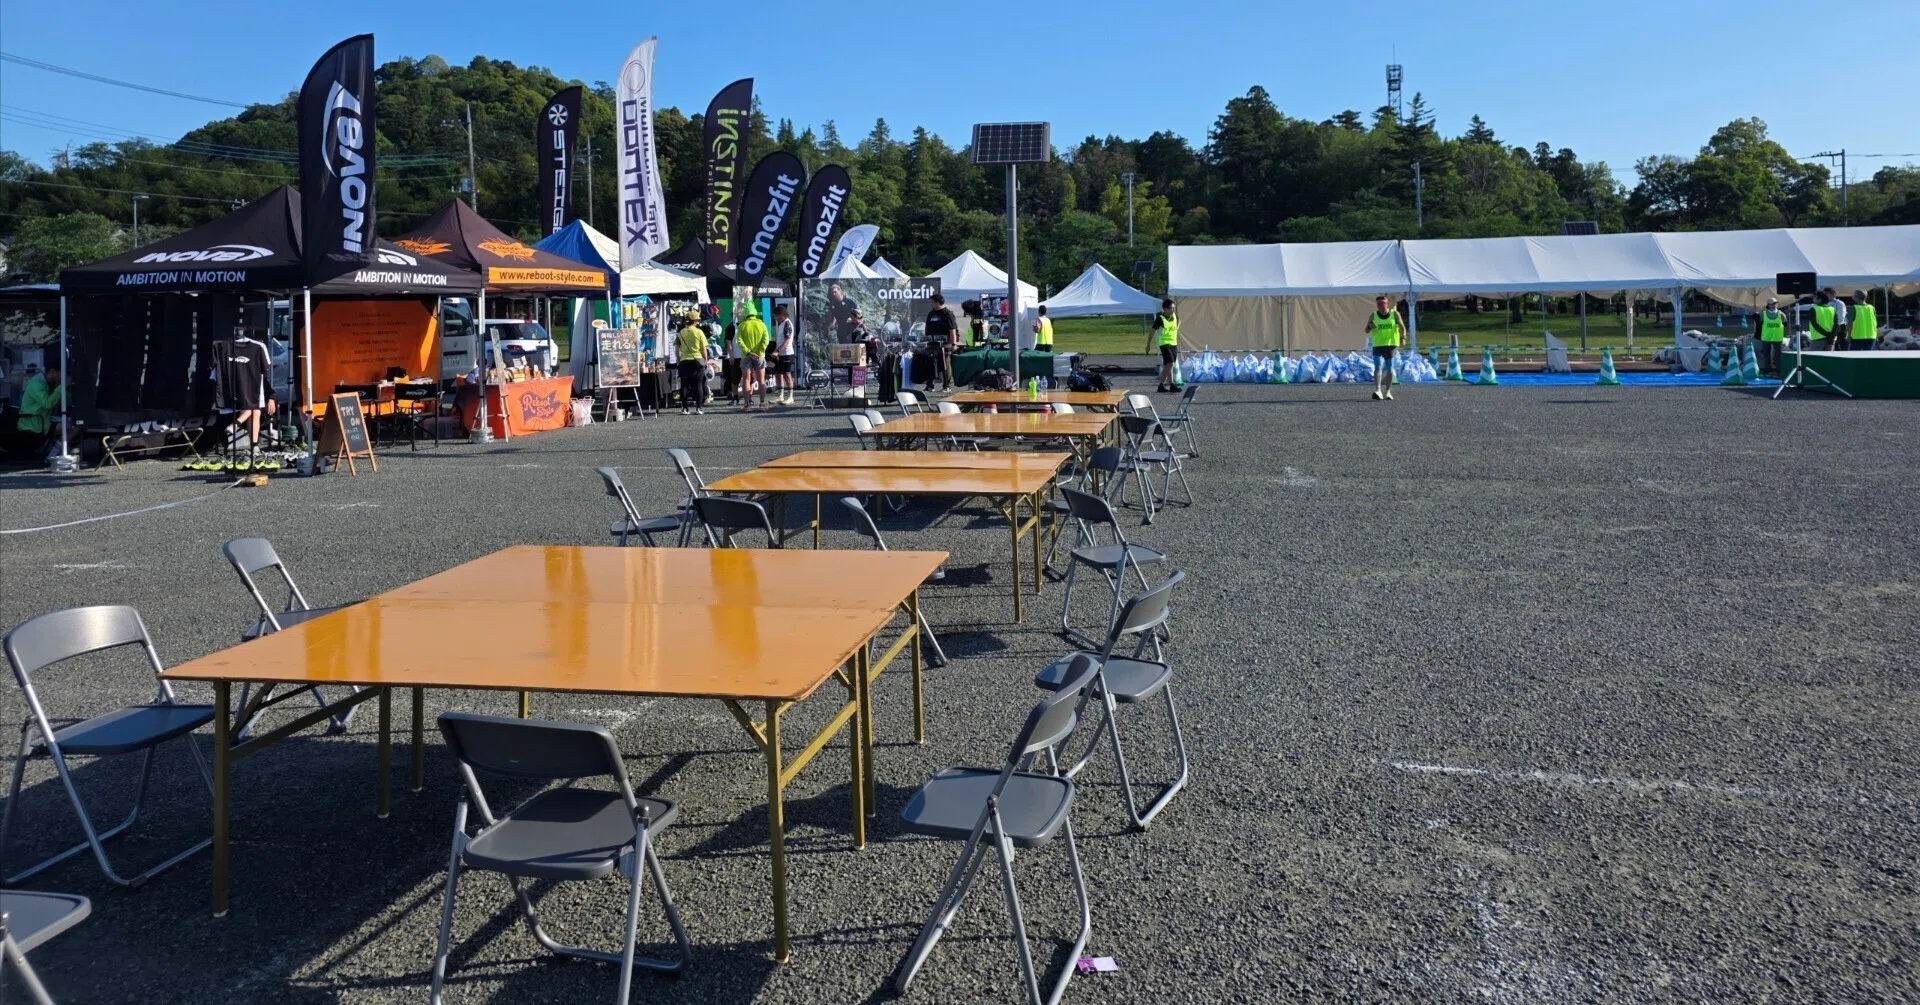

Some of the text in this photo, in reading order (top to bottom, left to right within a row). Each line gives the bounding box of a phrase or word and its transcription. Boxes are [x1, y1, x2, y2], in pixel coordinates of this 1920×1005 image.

[647, 201, 659, 245] Tape
[744, 173, 799, 274] amazfit
[803, 184, 846, 275] amazfit
[116, 271, 246, 286] AMBITION IN MOTION
[355, 271, 448, 286] AMBITION IN MOTION
[499, 271, 594, 283] www.reboot-style.com
[877, 284, 935, 300] amazfit
[600, 339, 636, 351] 走れる。
[340, 406, 354, 416] TRY
[522, 394, 550, 413] Reboot
